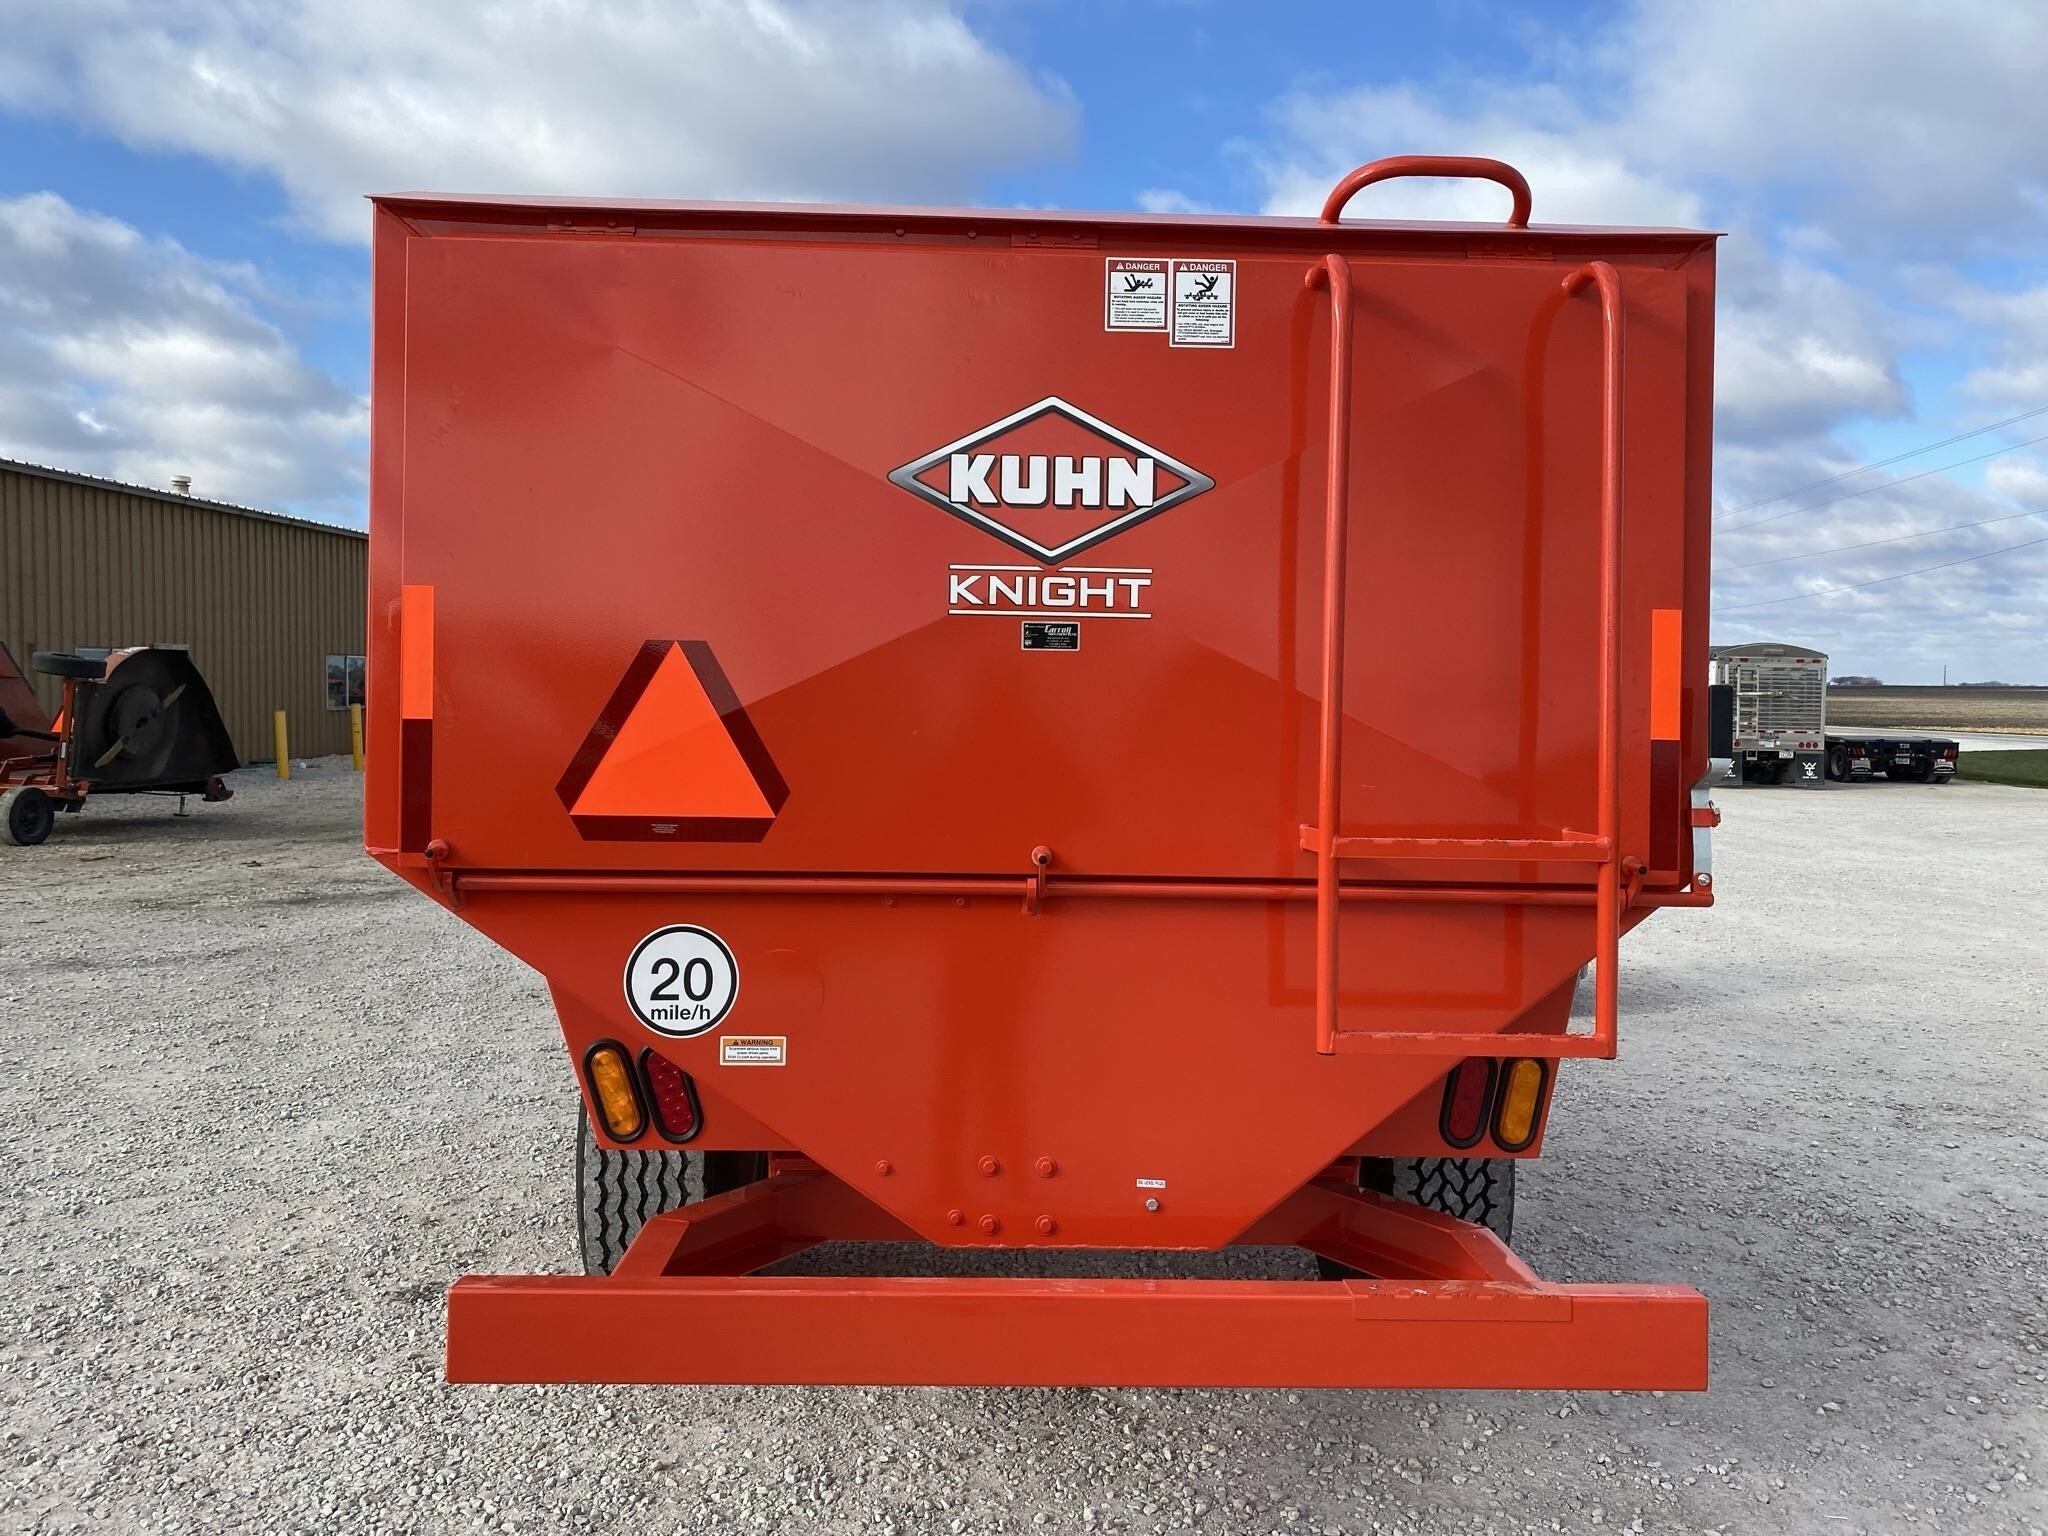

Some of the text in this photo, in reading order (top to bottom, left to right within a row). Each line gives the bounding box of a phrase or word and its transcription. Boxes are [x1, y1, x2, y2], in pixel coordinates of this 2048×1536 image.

[1190, 264, 1228, 272] DANGER
[950, 453, 1154, 508] KUHN
[950, 574, 1152, 608] KNIGHT
[650, 958, 713, 1002] 20
[650, 1004, 710, 1020] mile/h
